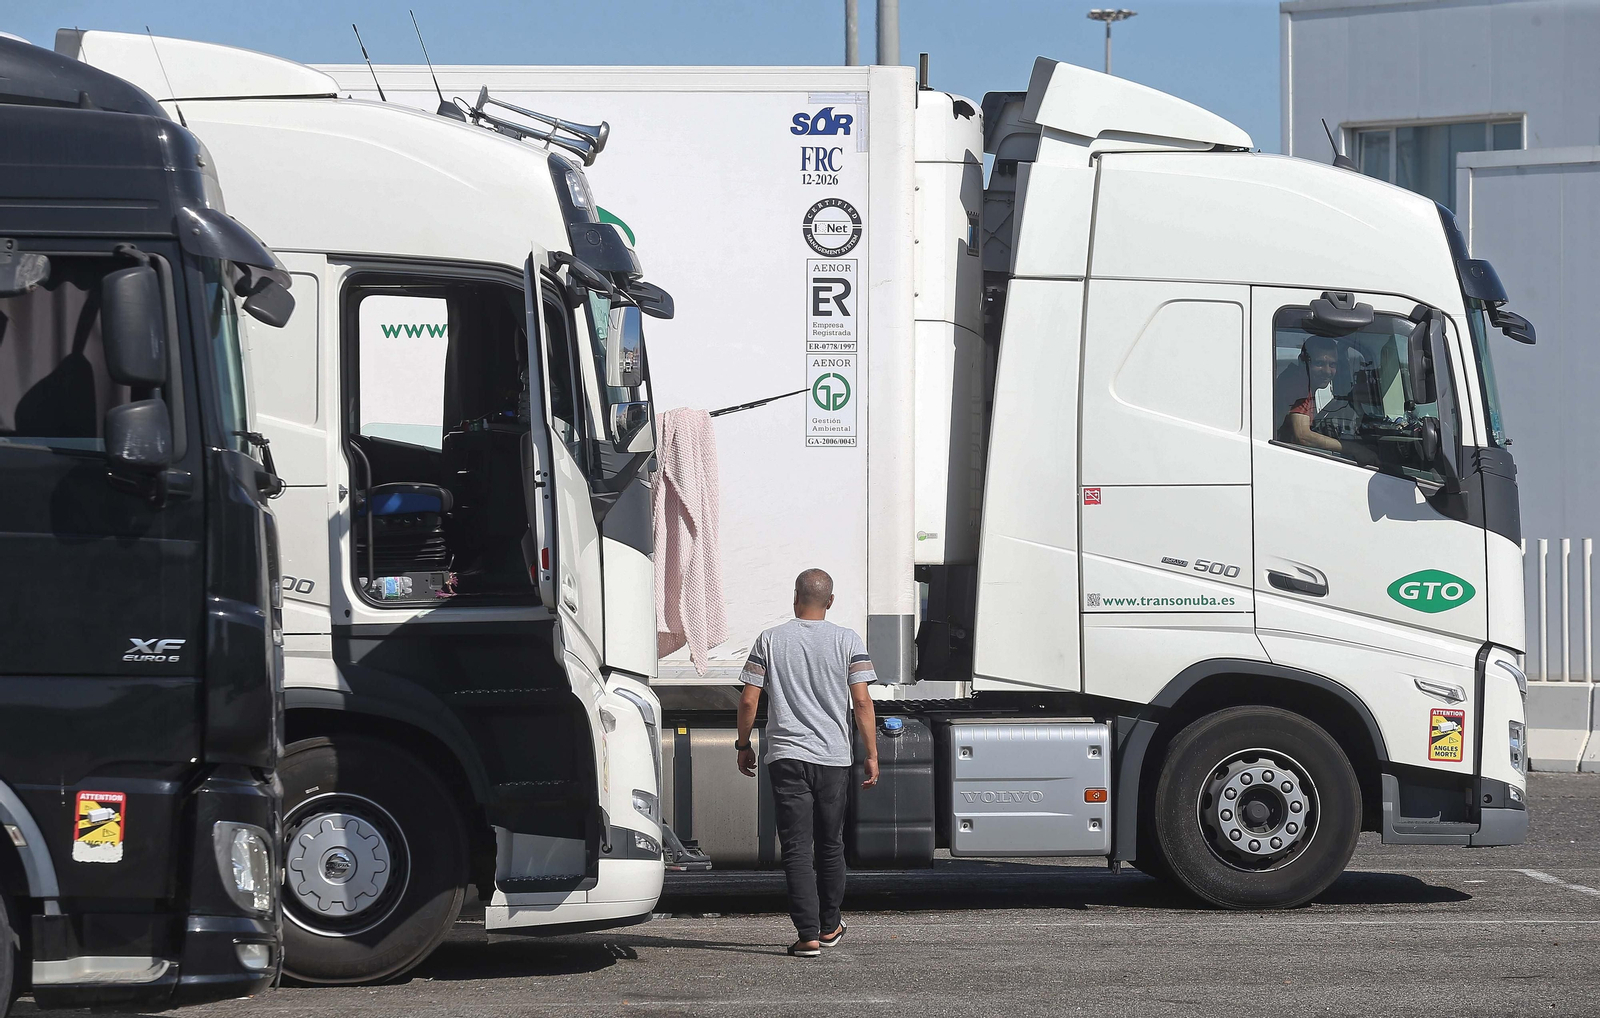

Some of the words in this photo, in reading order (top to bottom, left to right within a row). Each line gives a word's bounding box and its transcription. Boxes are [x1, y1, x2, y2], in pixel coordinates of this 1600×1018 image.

[800, 146, 843, 172] FRC
[802, 174, 839, 185] 12-2026
[807, 199, 858, 219] CERTIFIED
[813, 264, 852, 272] AENOR
[812, 277, 852, 316] ER
[812, 321, 844, 329] Empresa
[812, 329, 851, 337] Registrada
[812, 359, 851, 367] AENOR
[1193, 559, 1240, 578] 500
[1399, 582, 1464, 600] GTO
[1102, 595, 1235, 606] www.transonuba.es
[125, 638, 187, 654] XF
[122, 654, 167, 662] EURO
[168, 655, 180, 663] 6
[80, 793, 123, 801] ATTENTION
[960, 790, 1044, 803] VOLVO
